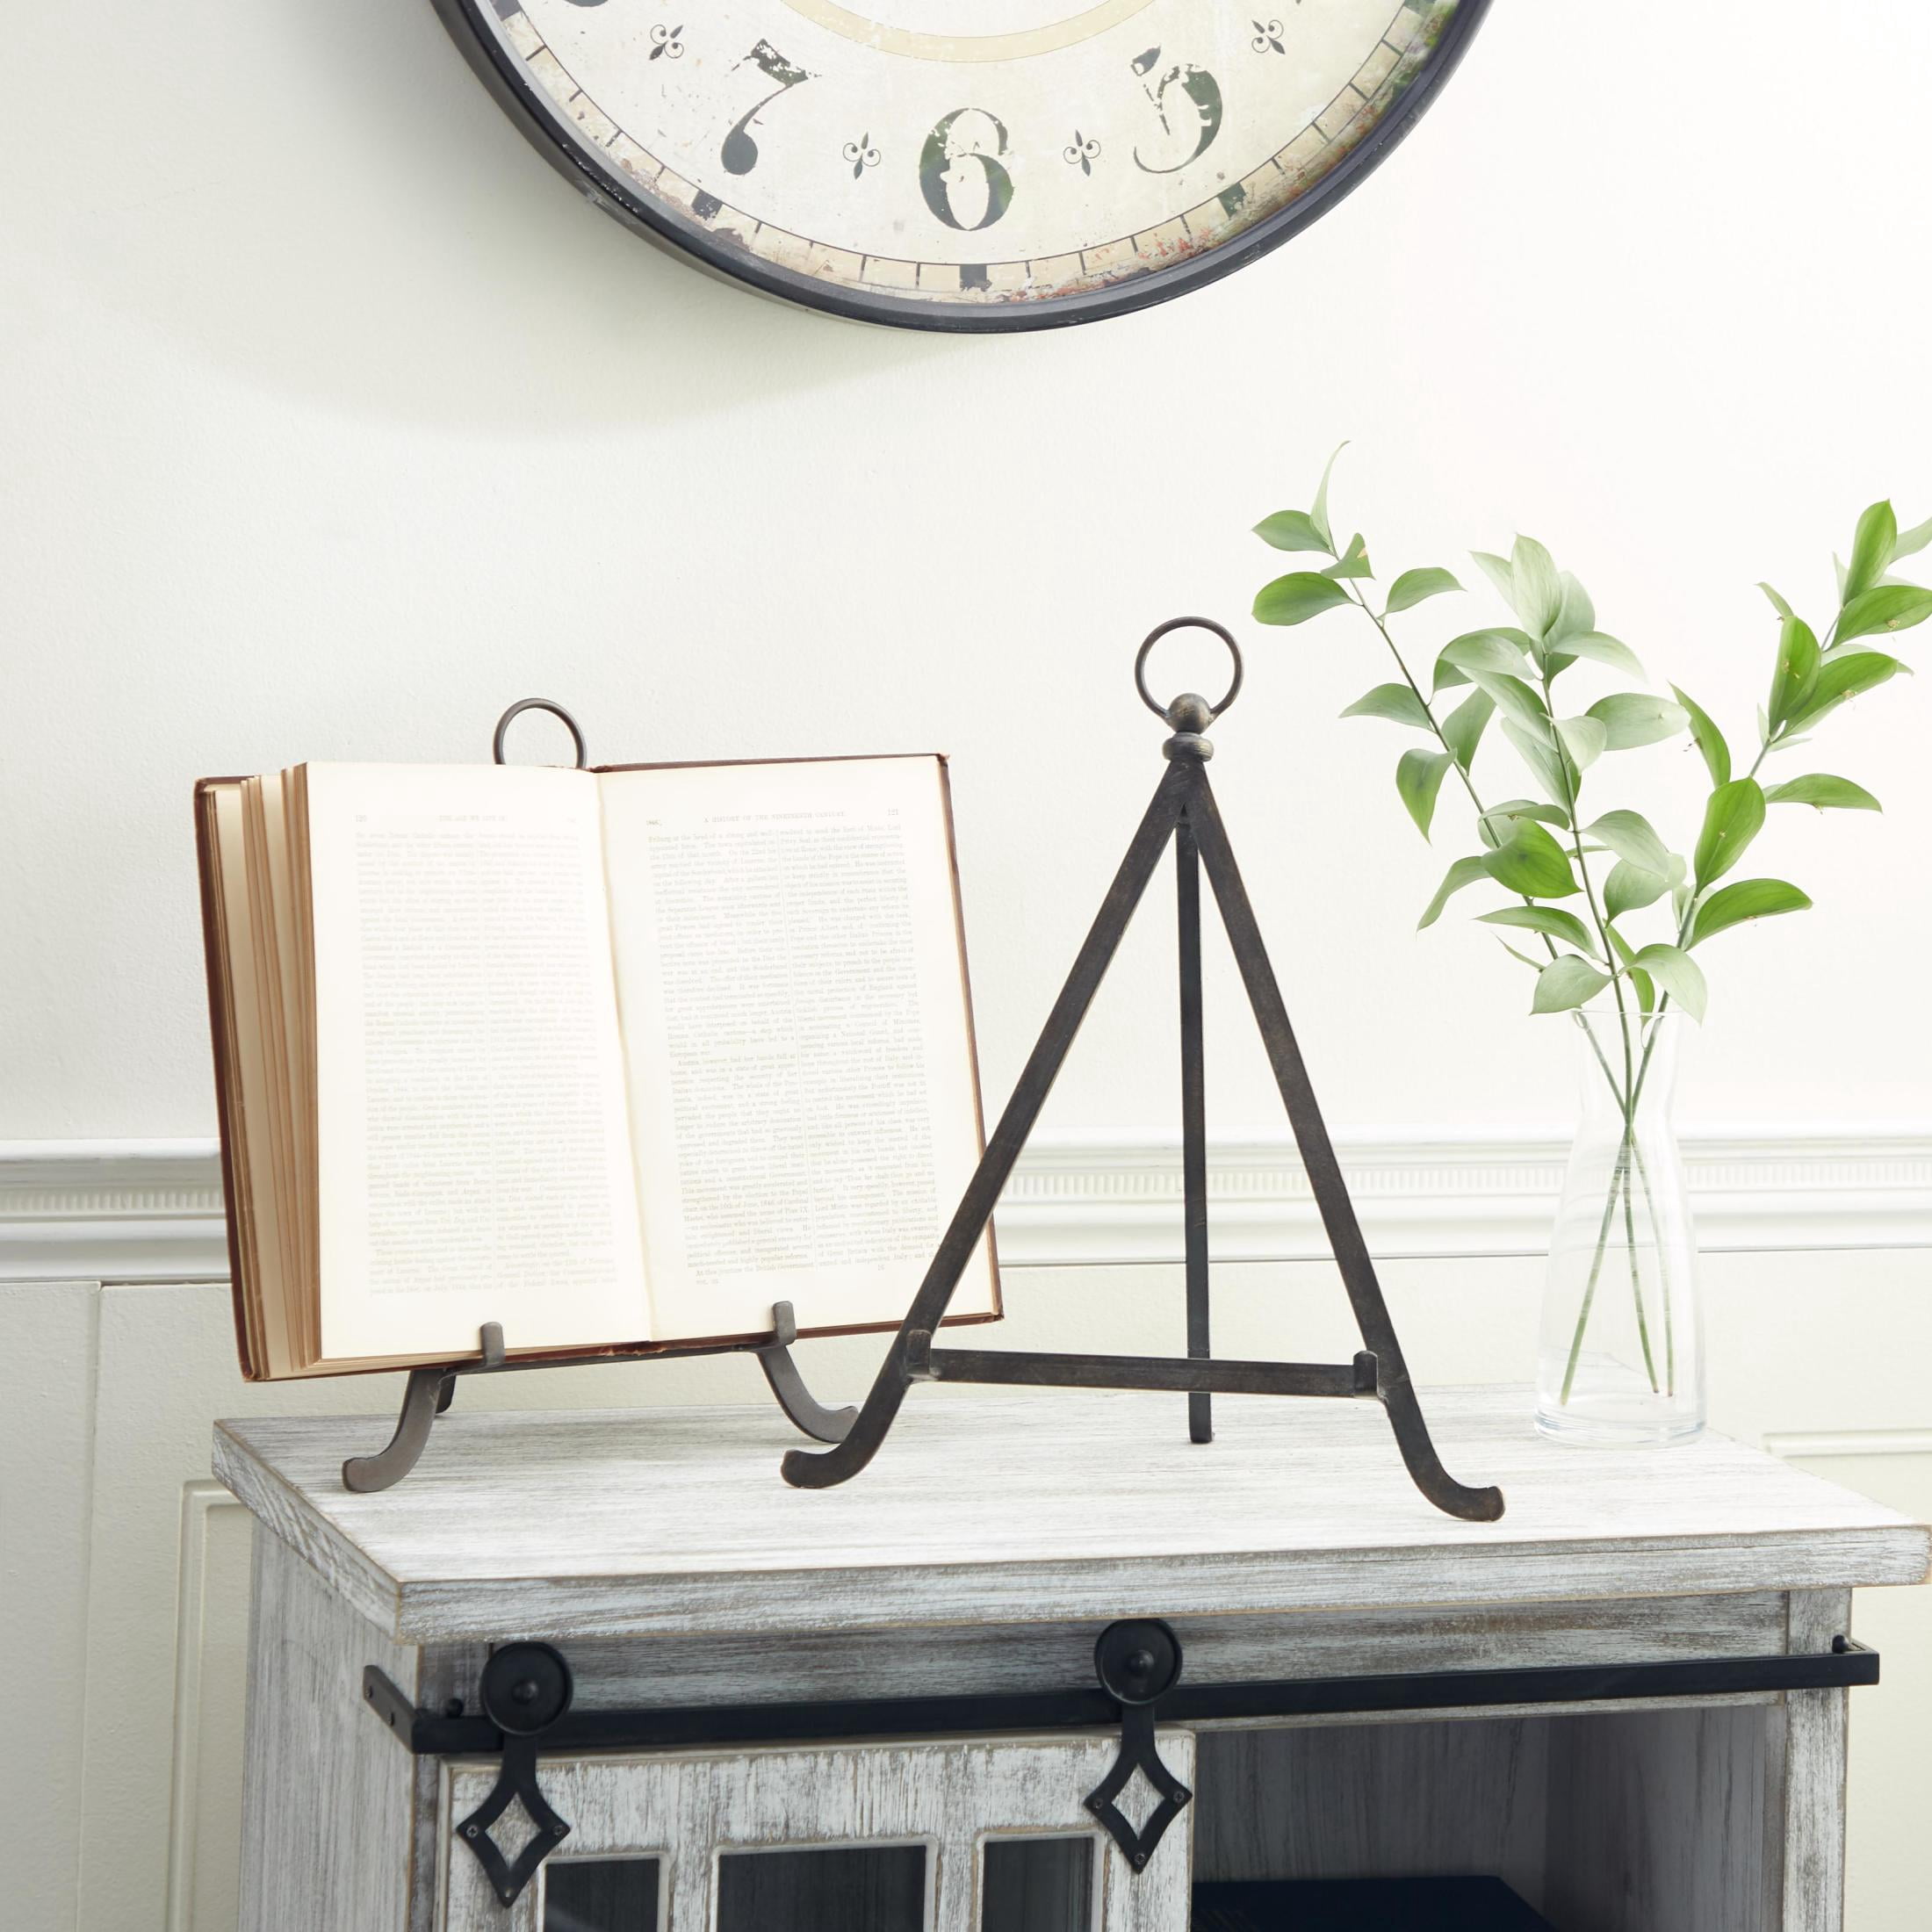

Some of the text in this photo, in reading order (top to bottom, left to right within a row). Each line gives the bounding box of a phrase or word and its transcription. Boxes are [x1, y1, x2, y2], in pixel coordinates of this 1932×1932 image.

[720, 37, 822, 176] 7
[919, 107, 1014, 231] 6
[1128, 45, 1223, 174] 5
